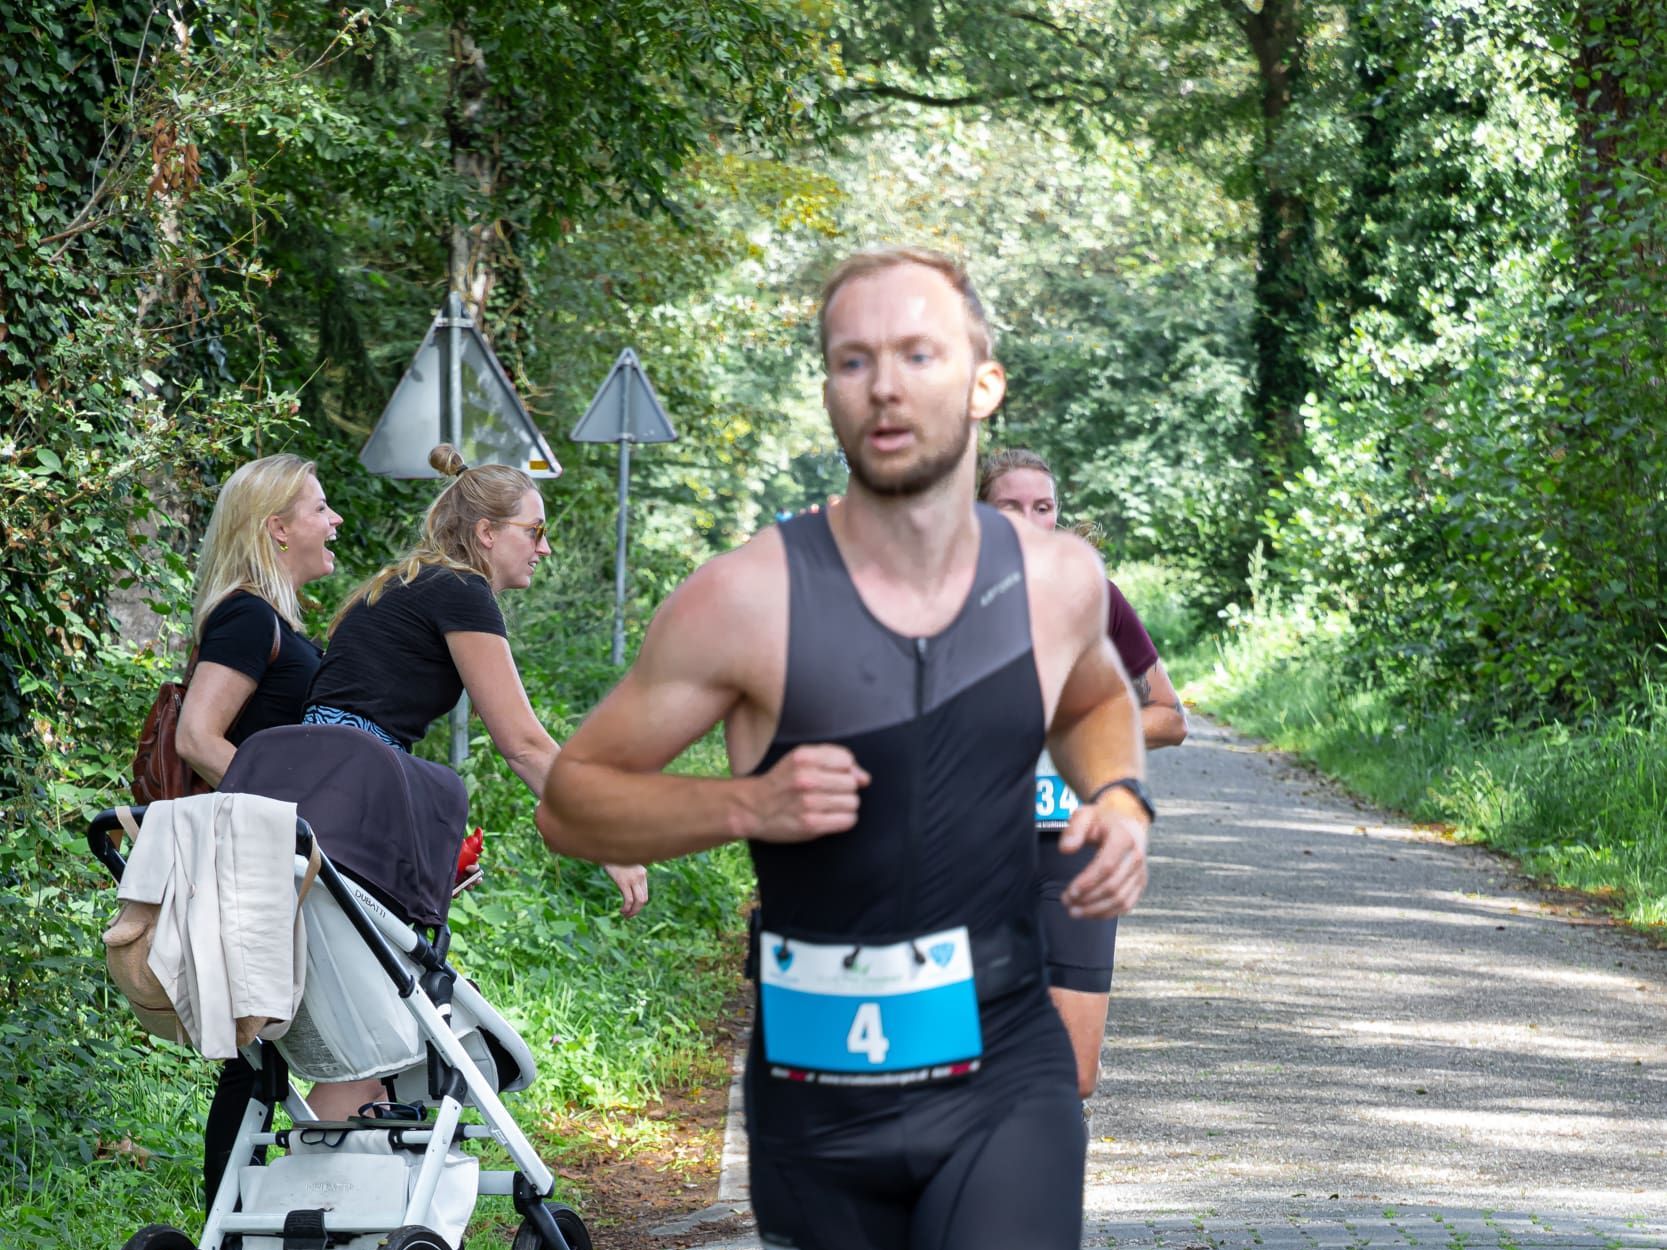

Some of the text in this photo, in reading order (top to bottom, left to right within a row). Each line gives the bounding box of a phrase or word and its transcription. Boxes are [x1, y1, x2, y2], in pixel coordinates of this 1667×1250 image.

[1035, 778, 1079, 817] 34
[354, 889, 386, 919] DUBATTI
[847, 1002, 890, 1064] 4
